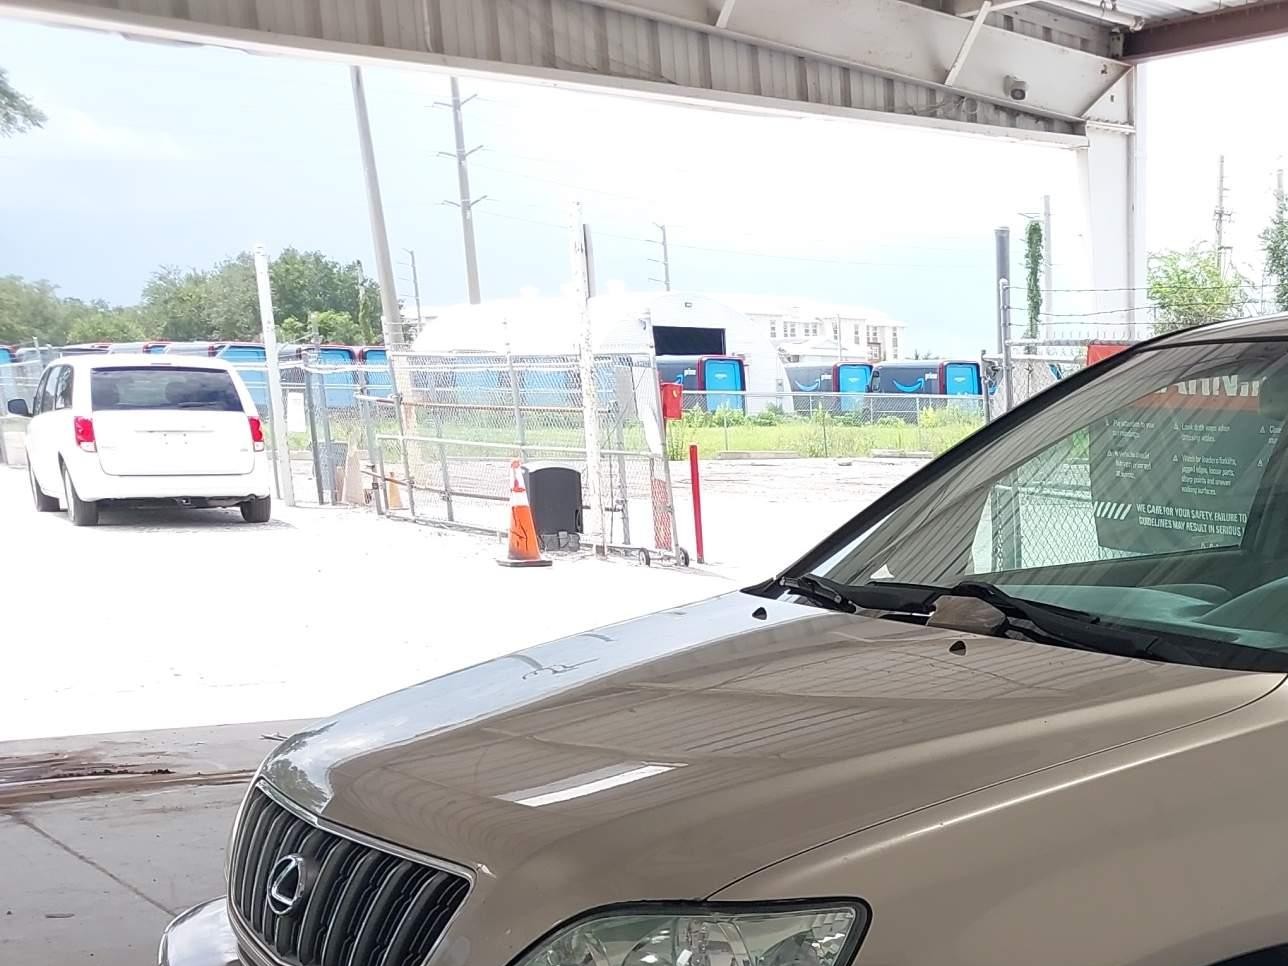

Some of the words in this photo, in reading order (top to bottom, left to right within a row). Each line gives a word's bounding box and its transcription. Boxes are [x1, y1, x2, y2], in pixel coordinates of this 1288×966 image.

[1136, 503, 1146, 512] WE
[1147, 504, 1163, 515] CARE
[1163, 506, 1174, 516] FOR
[1175, 507, 1190, 518] YOUR
[1214, 512, 1238, 522] FAILURE
[1139, 516, 1172, 528] GUIDELINES
[1172, 521, 1185, 530] MAY
[1186, 522, 1207, 532] RESULT
[1208, 524, 1215, 533] IN
[1215, 525, 1241, 537] SERIOUS
